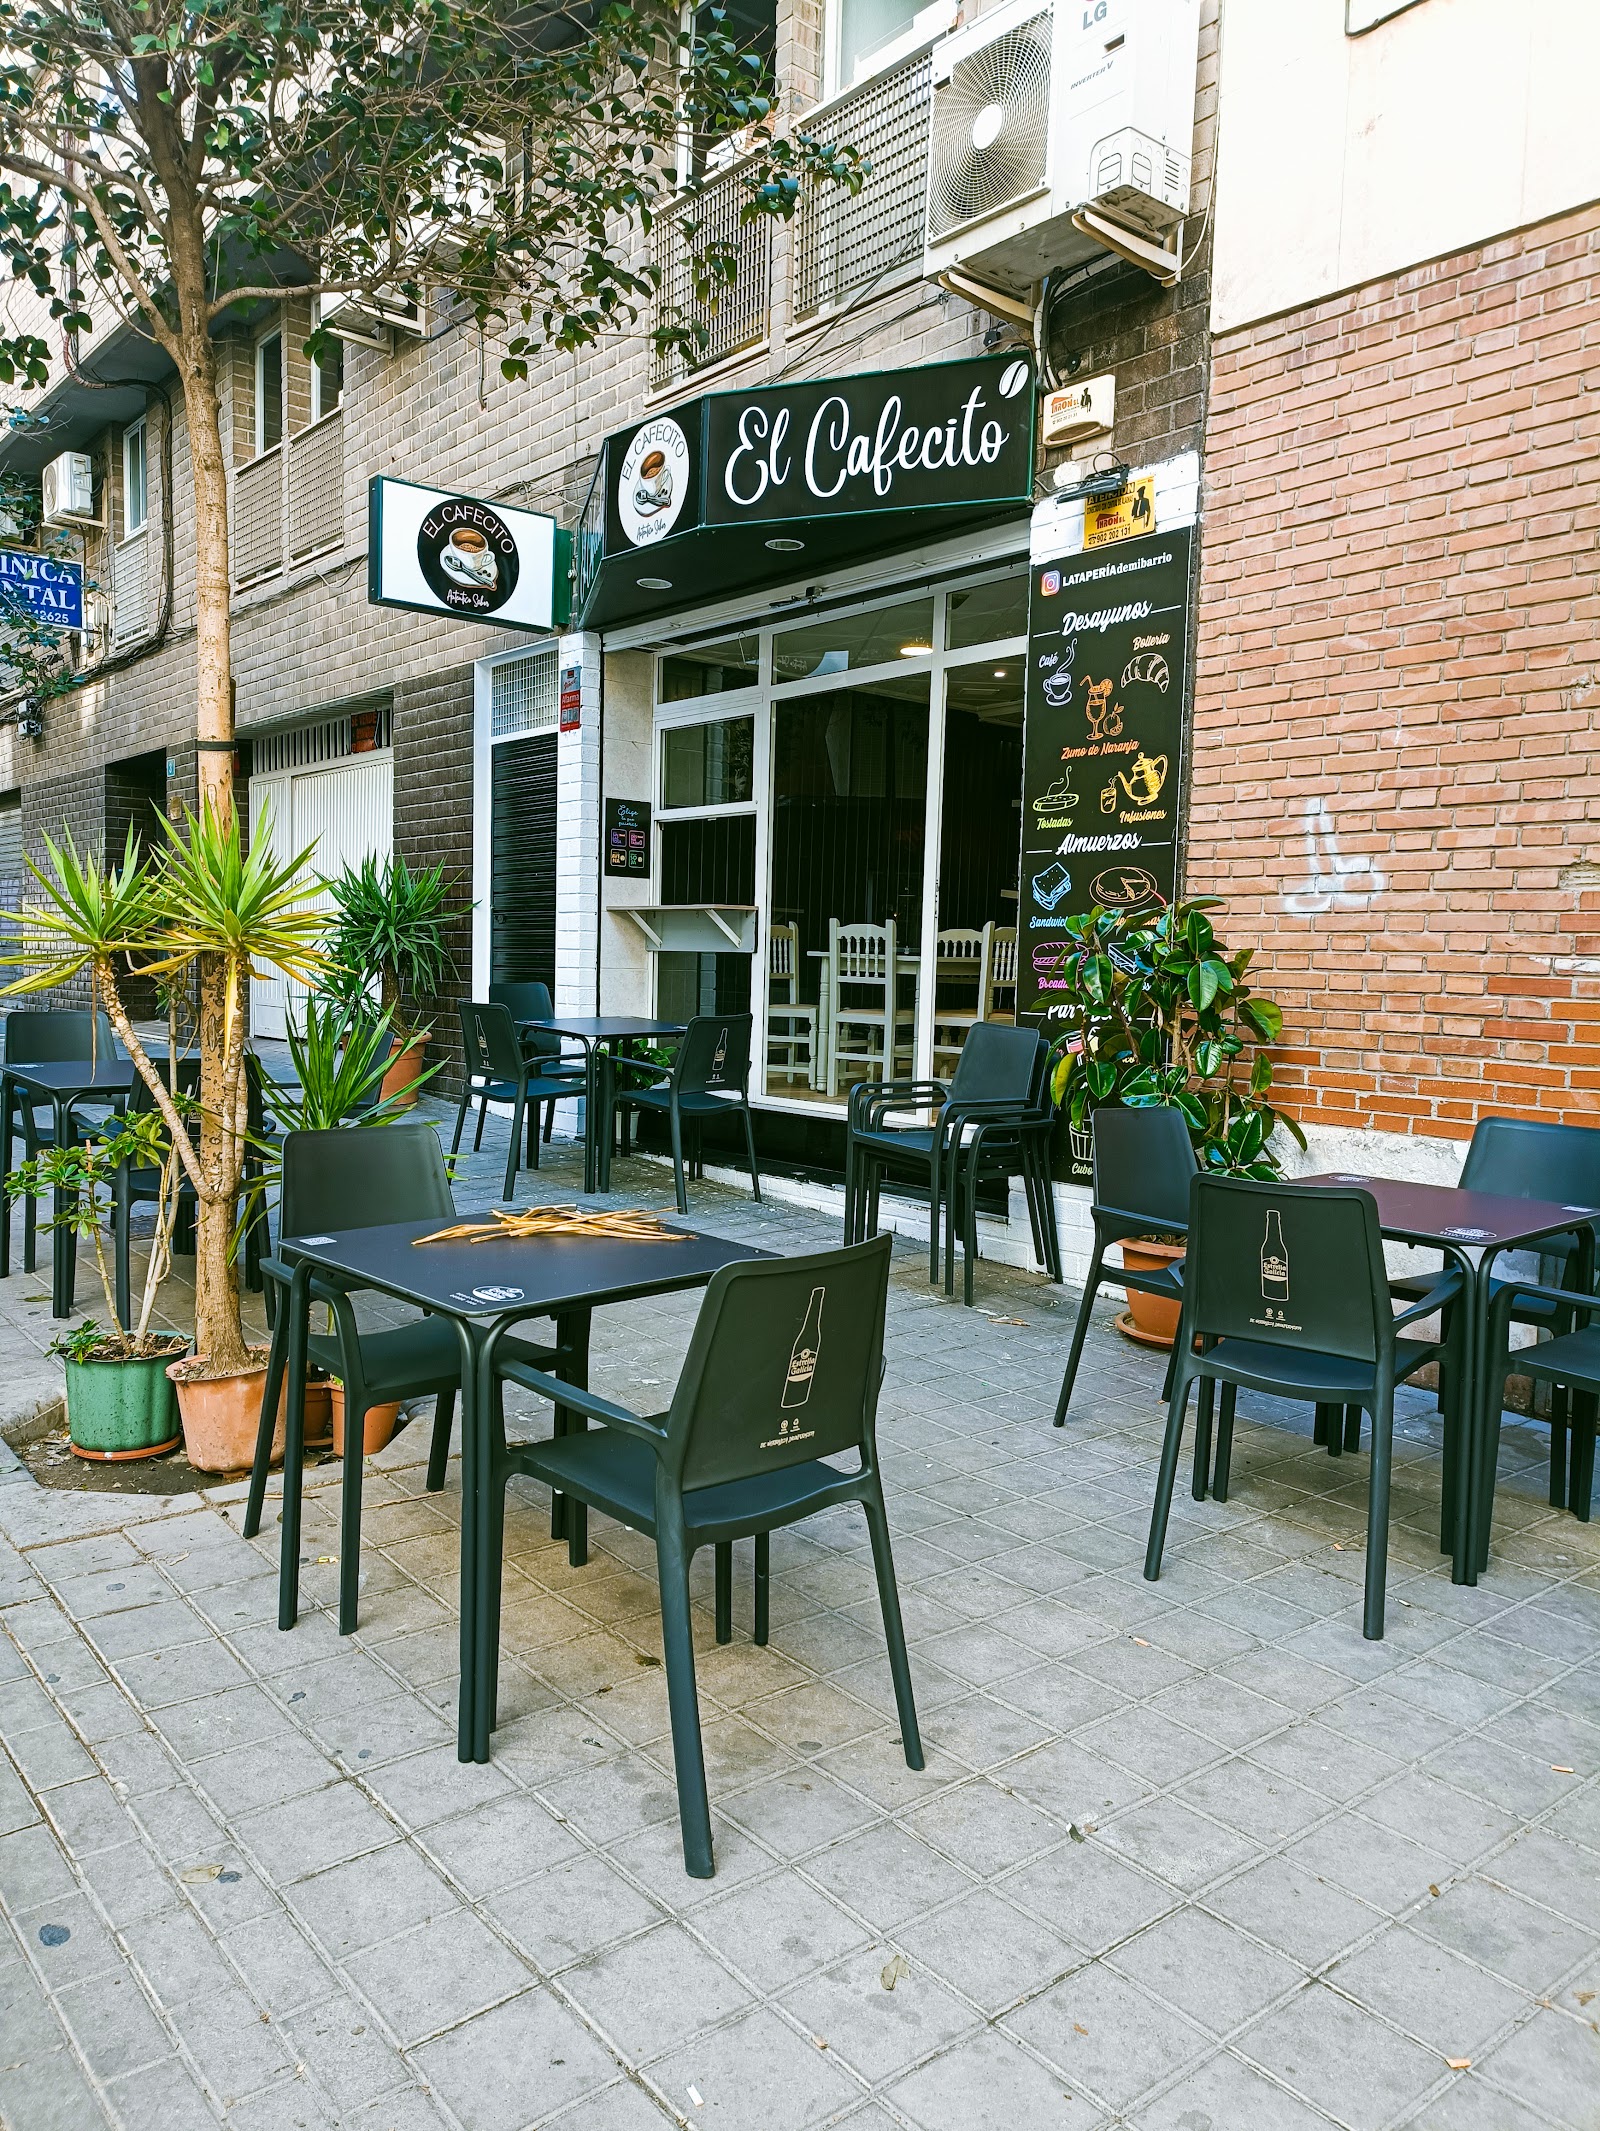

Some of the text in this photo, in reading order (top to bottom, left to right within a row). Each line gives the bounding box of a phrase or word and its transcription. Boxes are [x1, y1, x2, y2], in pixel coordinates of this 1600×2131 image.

[1083, 1, 1108, 30] LG
[622, 424, 686, 481] EL CAFECITO
[724, 385, 1010, 505] El Cafecito
[422, 505, 514, 554] EL CAFECITO
[1096, 533, 1107, 543] 902
[1109, 529, 1119, 540] 202
[1121, 526, 1131, 537] 131
[1061, 600, 1153, 636] Desayunos
[1039, 652, 1059, 668] Café
[1061, 739, 1140, 760] Zumo de Naranja
[1036, 817, 1074, 830] Tostadas
[1119, 809, 1167, 824] Infusiones
[1055, 832, 1143, 855] Almuerzos
[1071, 1162, 1094, 1175] Cubo
